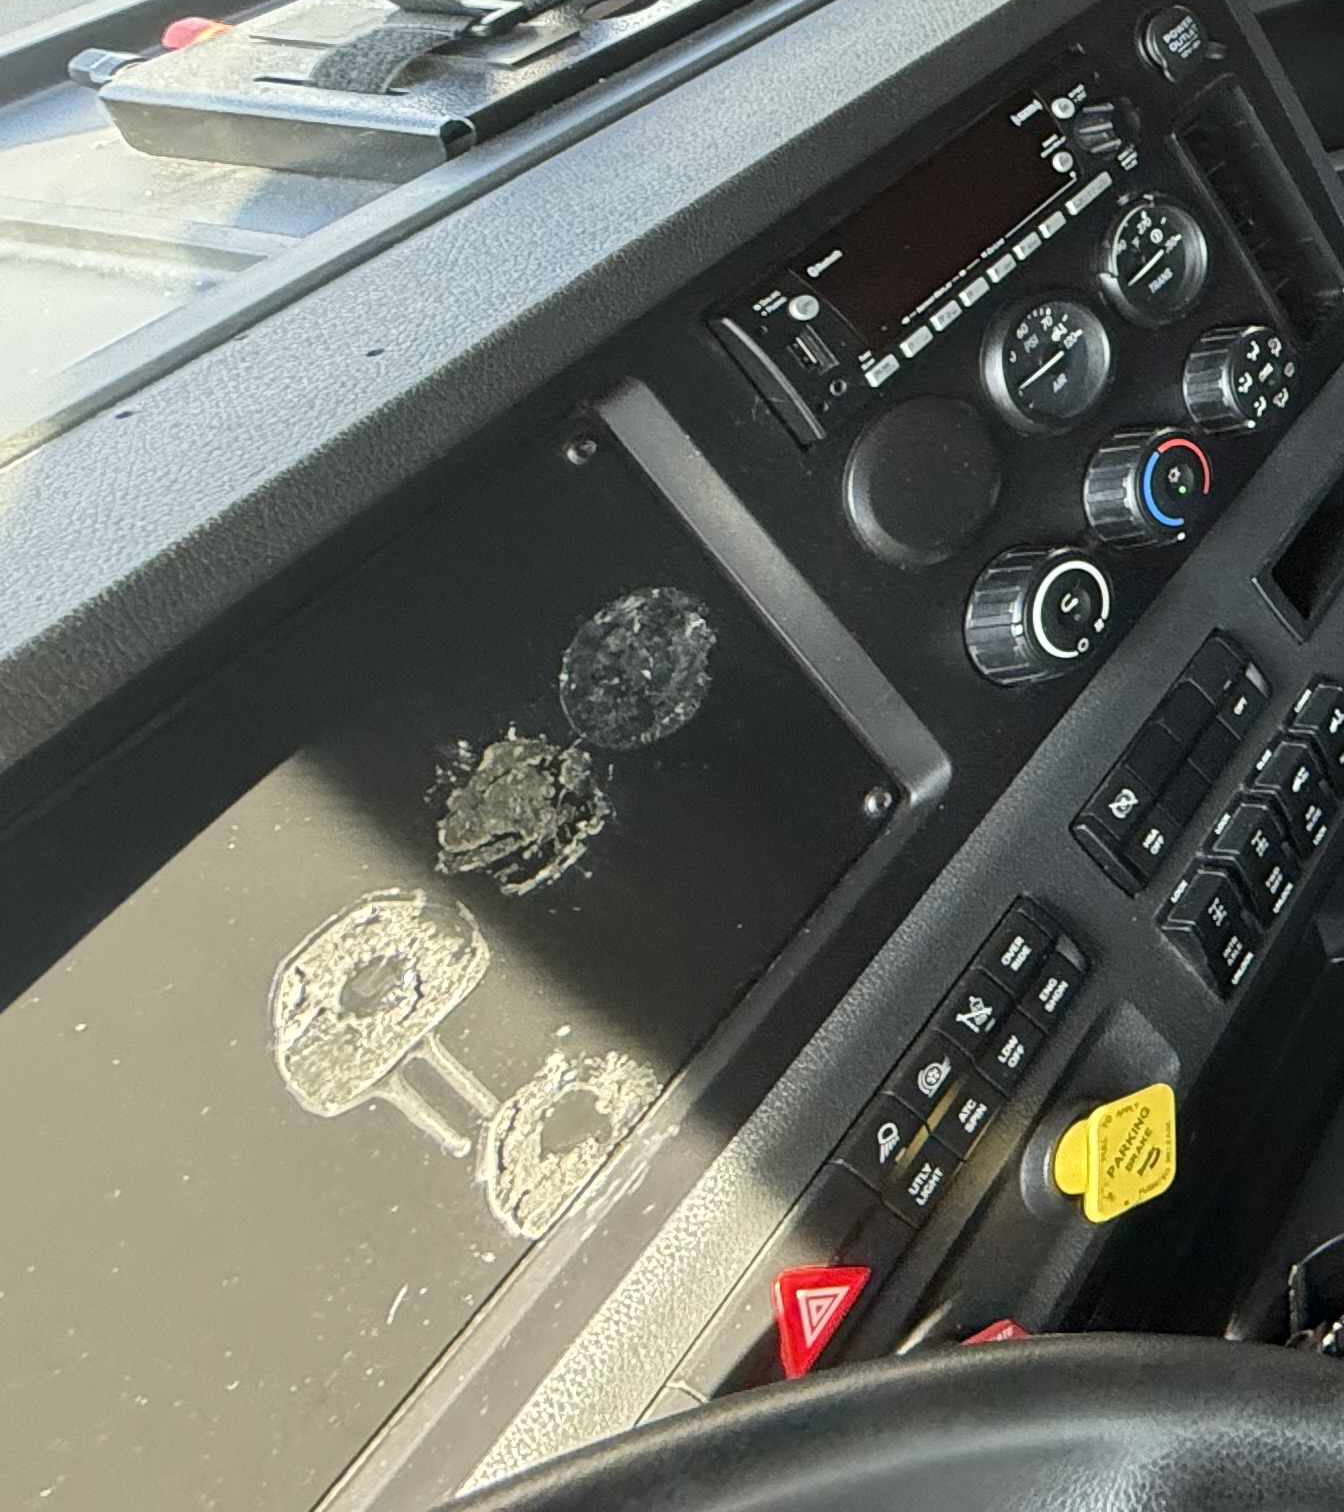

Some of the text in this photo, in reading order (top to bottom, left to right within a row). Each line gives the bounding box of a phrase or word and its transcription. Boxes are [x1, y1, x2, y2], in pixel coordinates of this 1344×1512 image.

[1162, 15, 1193, 44] POWER
[1168, 23, 1198, 53] OUTLET
[1148, 267, 1174, 294] TRANS
[1149, 834, 1165, 855] OFF
[1001, 935, 1025, 966] OVER
[1010, 944, 1032, 972] RIDE
[1038, 977, 1058, 1002] ENG
[1044, 980, 1069, 1013] SHDN
[997, 1034, 1019, 1063] LDW
[1007, 1043, 1025, 1068] OFF
[958, 1098, 978, 1124] ATC
[964, 1102, 988, 1133] SPIN
[1106, 1106, 1151, 1179] PARKING
[1125, 1127, 1153, 1172] BRAKE
[907, 1161, 932, 1196] UTLY
[915, 1166, 944, 1206] LIGHT
